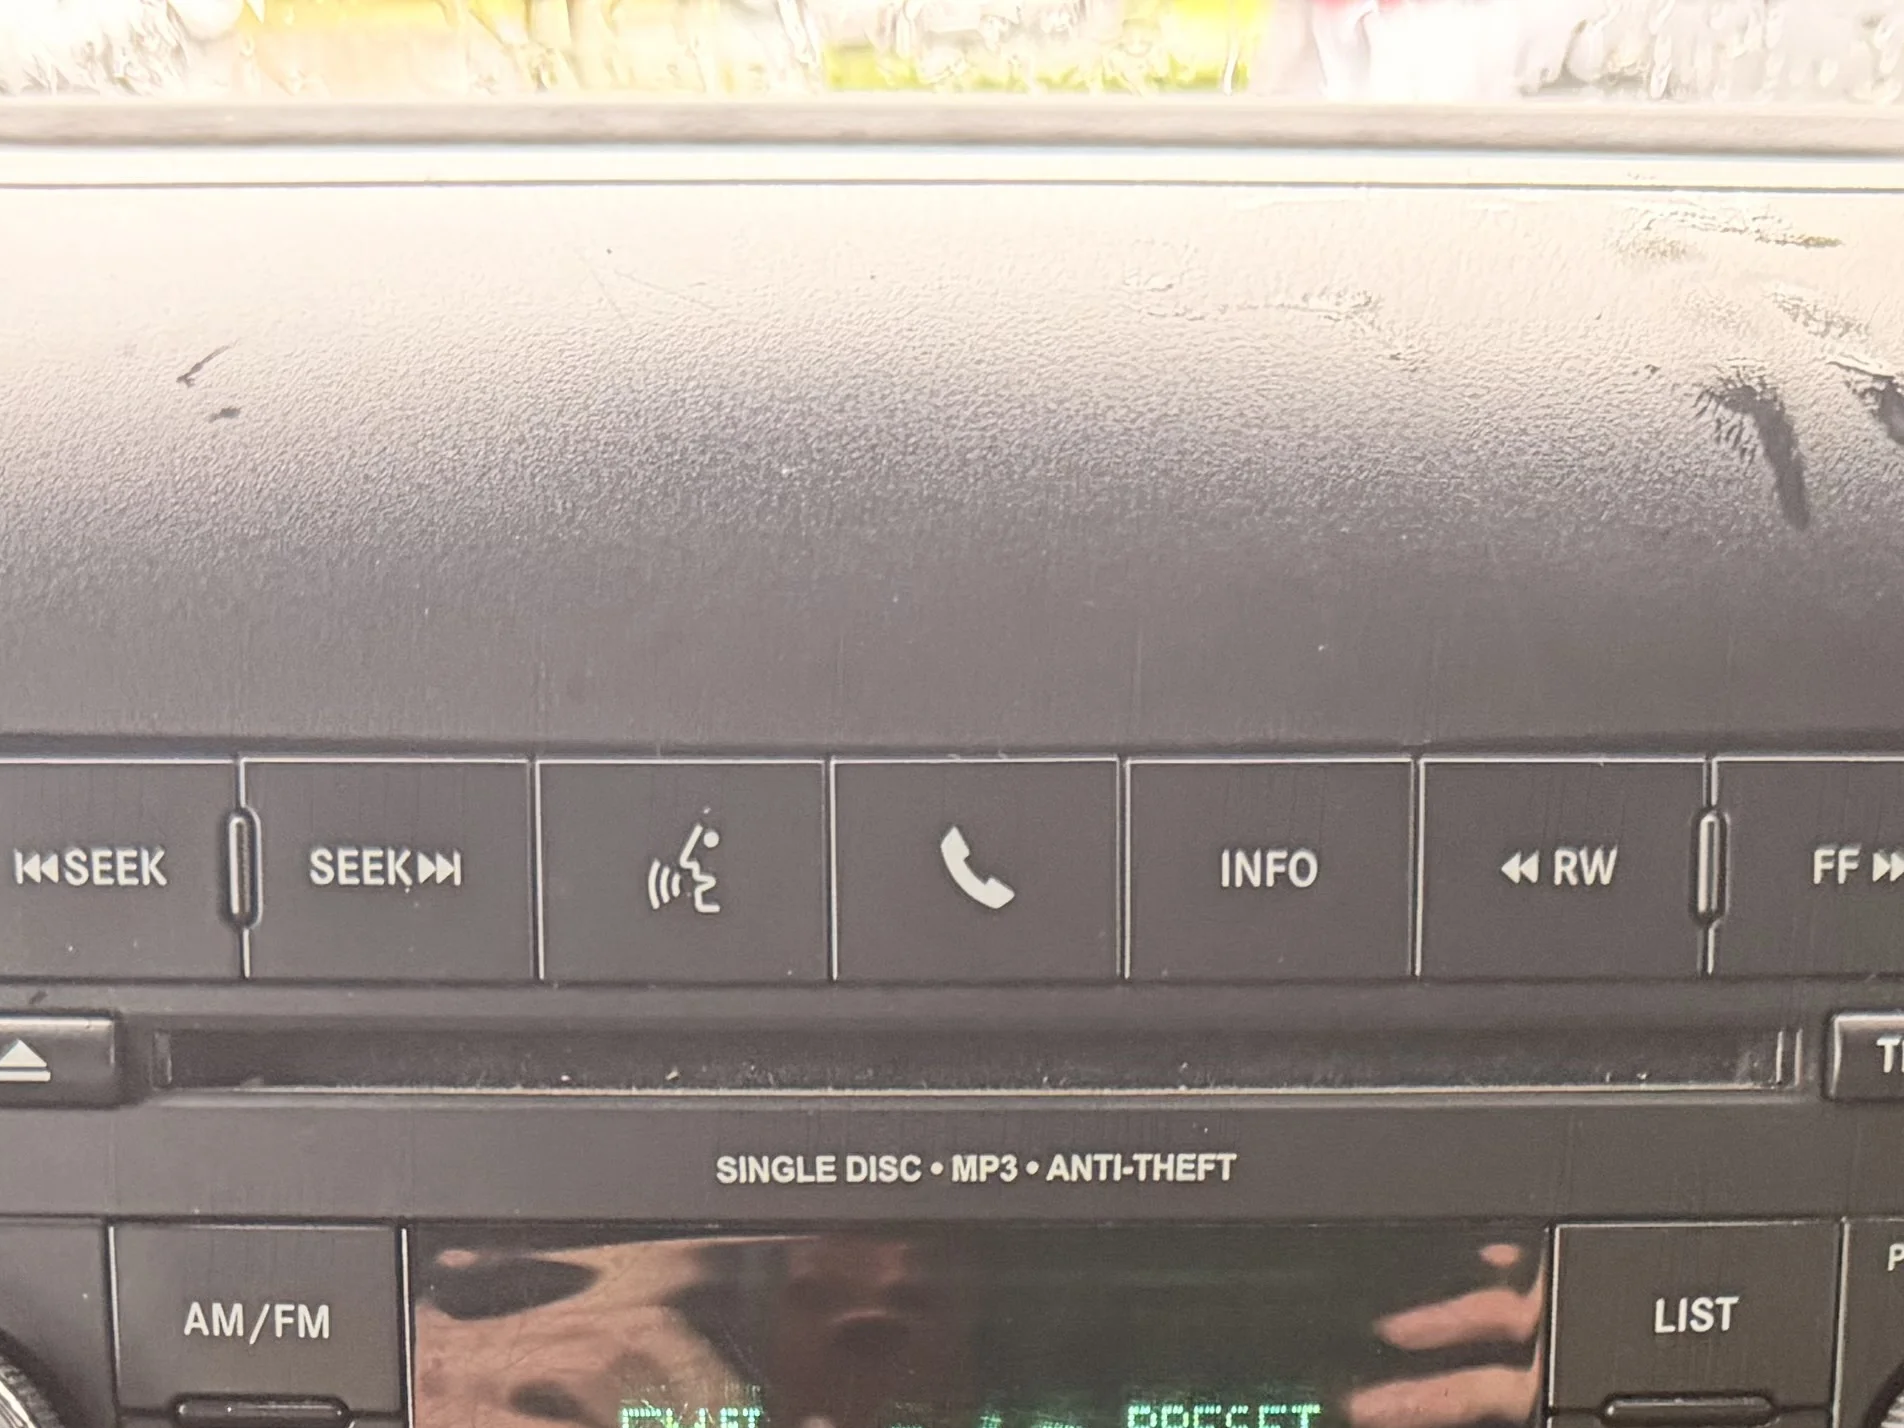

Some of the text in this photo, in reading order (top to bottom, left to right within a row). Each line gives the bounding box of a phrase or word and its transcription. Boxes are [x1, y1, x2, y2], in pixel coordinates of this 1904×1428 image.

[64, 848, 167, 886] SEEK
[310, 847, 413, 886] SEEK
[1221, 849, 1318, 888] INFO
[1554, 847, 1618, 886] RW
[1813, 847, 1860, 885] FF
[716, 1153, 1238, 1184] SINGLE DISC MP3 ANTI-THEFT
[183, 1301, 330, 1345] AM/FM
[1654, 1296, 1739, 1333] LIST
